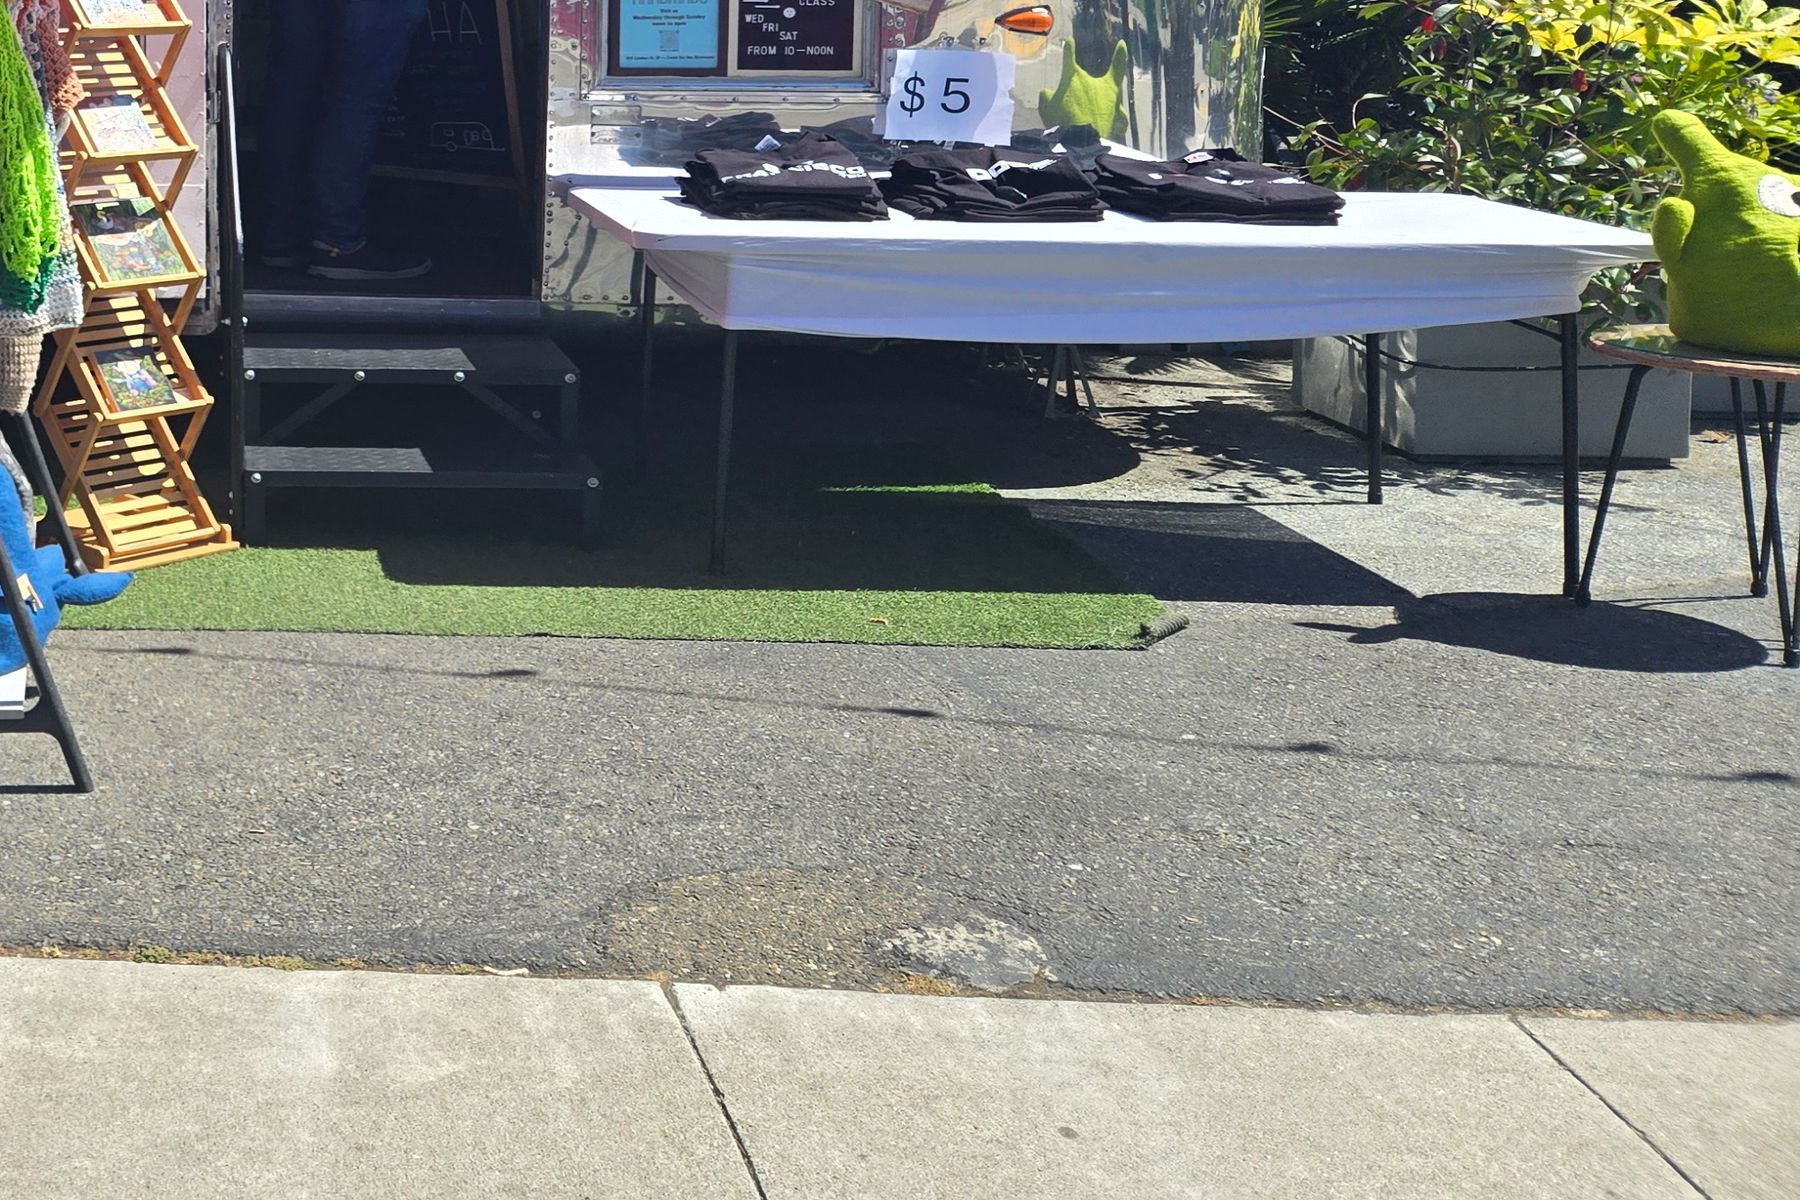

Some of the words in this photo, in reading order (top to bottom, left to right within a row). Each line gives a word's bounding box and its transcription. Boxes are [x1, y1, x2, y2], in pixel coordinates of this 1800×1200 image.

[744, 14, 765, 24] WED
[762, 22, 780, 32] FRI
[779, 30, 798, 41] SAT
[747, 45, 777, 56] FROM
